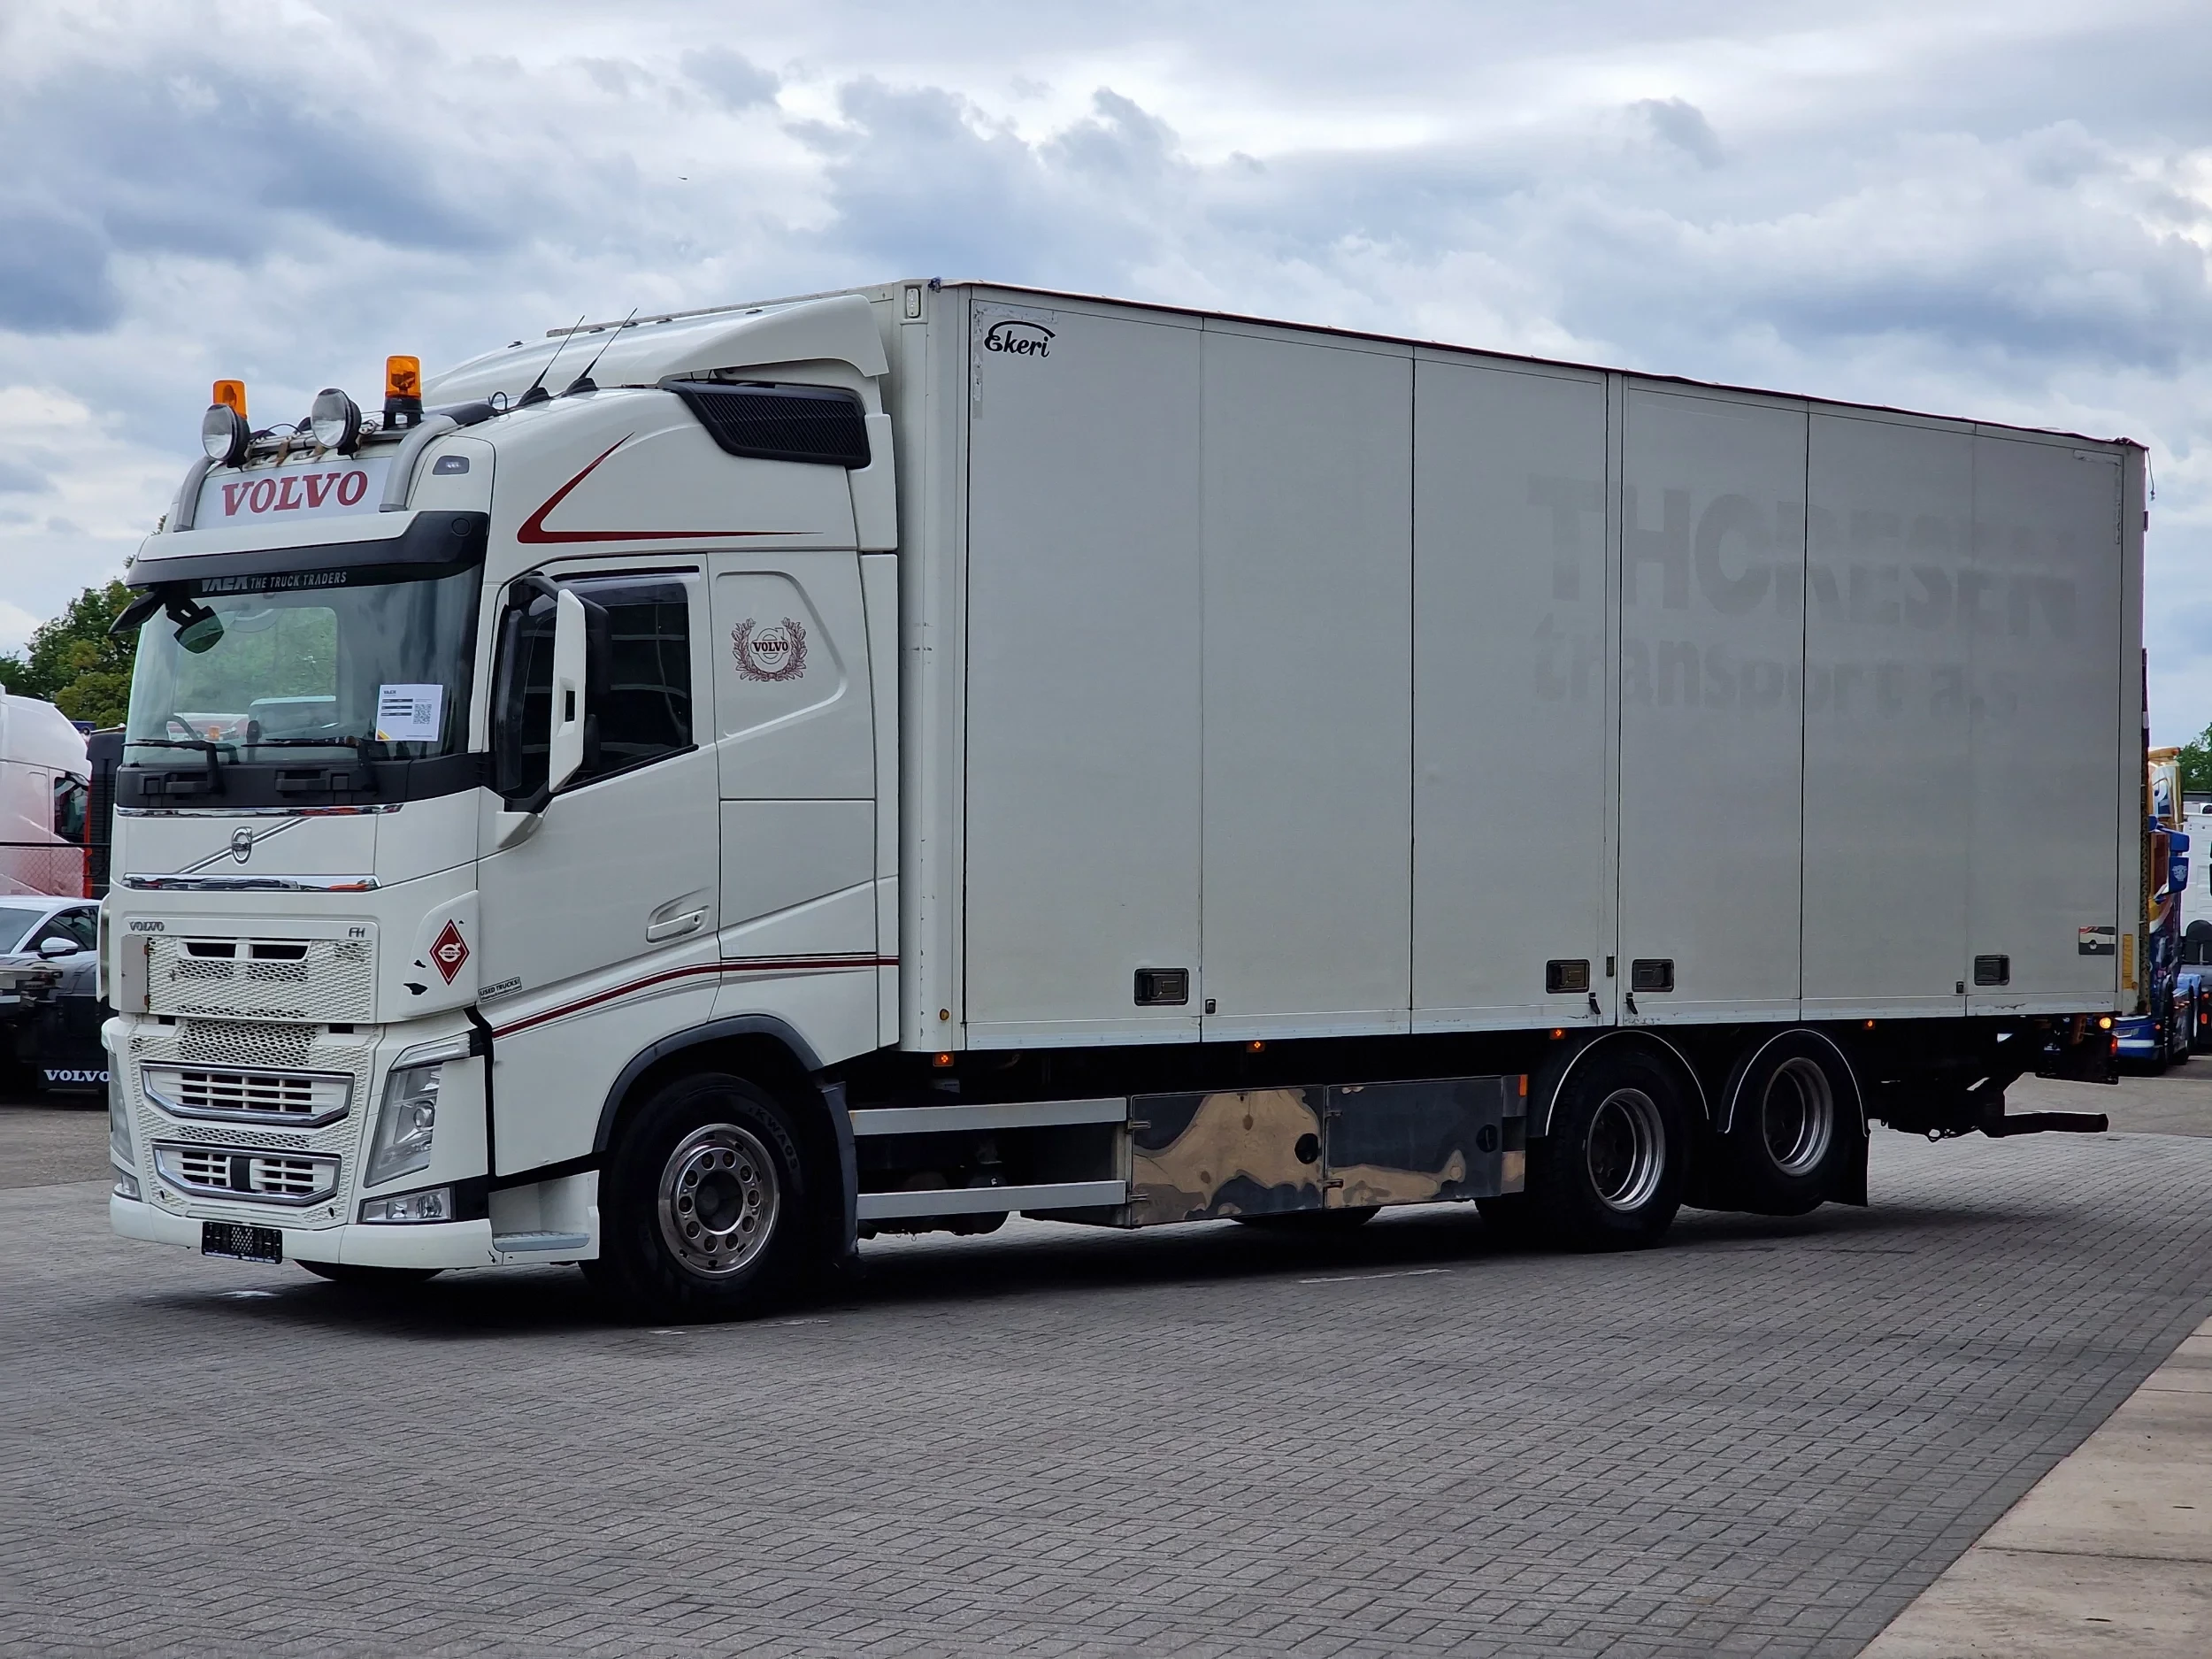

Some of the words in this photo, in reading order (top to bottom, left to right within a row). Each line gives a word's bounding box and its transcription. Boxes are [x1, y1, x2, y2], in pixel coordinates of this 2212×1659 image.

[984, 320, 1056, 357] Ekeri
[222, 470, 368, 517] VOLVO
[1527, 472, 2078, 639] THORESEN
[250, 577, 266, 589] THE
[270, 574, 299, 588] TRUCK
[303, 572, 347, 585] TRADERS
[752, 641, 788, 652] VOLVO
[129, 921, 165, 932] VOLVO
[348, 927, 365, 938] FH
[480, 987, 495, 996] USED
[43, 1069, 110, 1082] VOLVO
